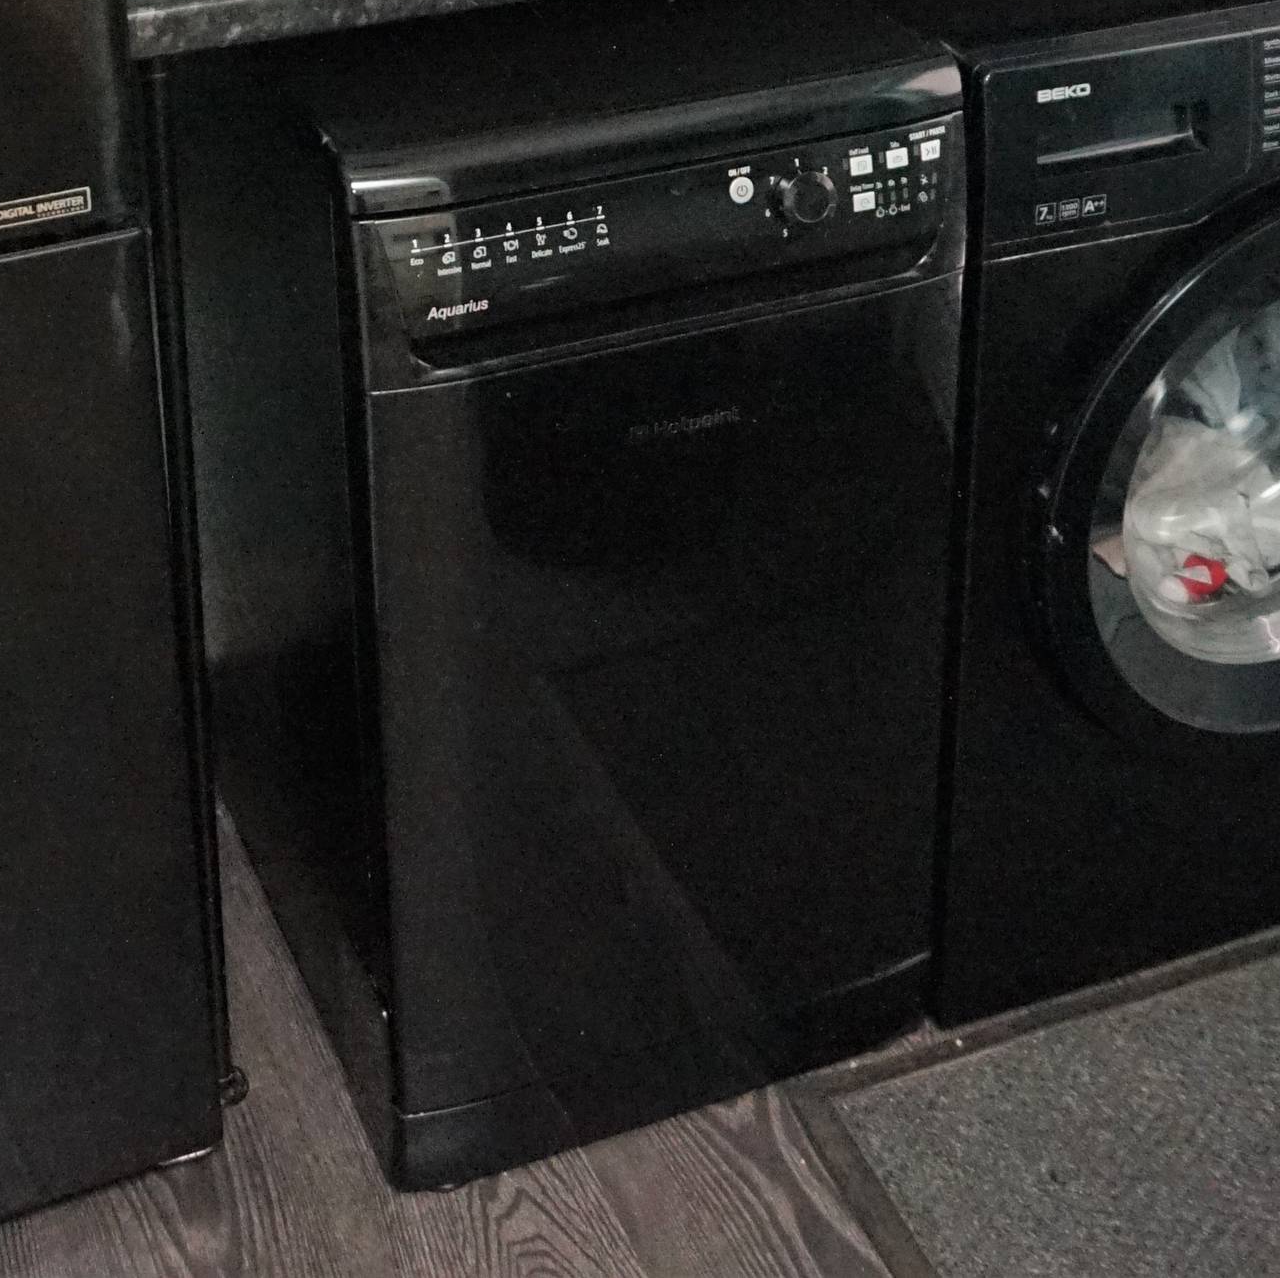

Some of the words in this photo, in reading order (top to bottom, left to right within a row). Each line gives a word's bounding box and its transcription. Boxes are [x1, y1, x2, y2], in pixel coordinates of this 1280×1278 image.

[1037, 82, 1091, 103] BEKO
[36, 195, 84, 213] INVERTER
[596, 206, 603, 215] 7
[567, 211, 573, 220] 6
[536, 217, 542, 226] 5
[506, 223, 512, 232] 4
[475, 228, 481, 237] 3
[444, 234, 450, 243] 2
[412, 239, 418, 248] 1
[531, 249, 553, 259] Delicate
[410, 257, 424, 266] Eco
[506, 255, 517, 264] Fast
[471, 260, 491, 270] Normal
[427, 298, 489, 321] Aquarius
